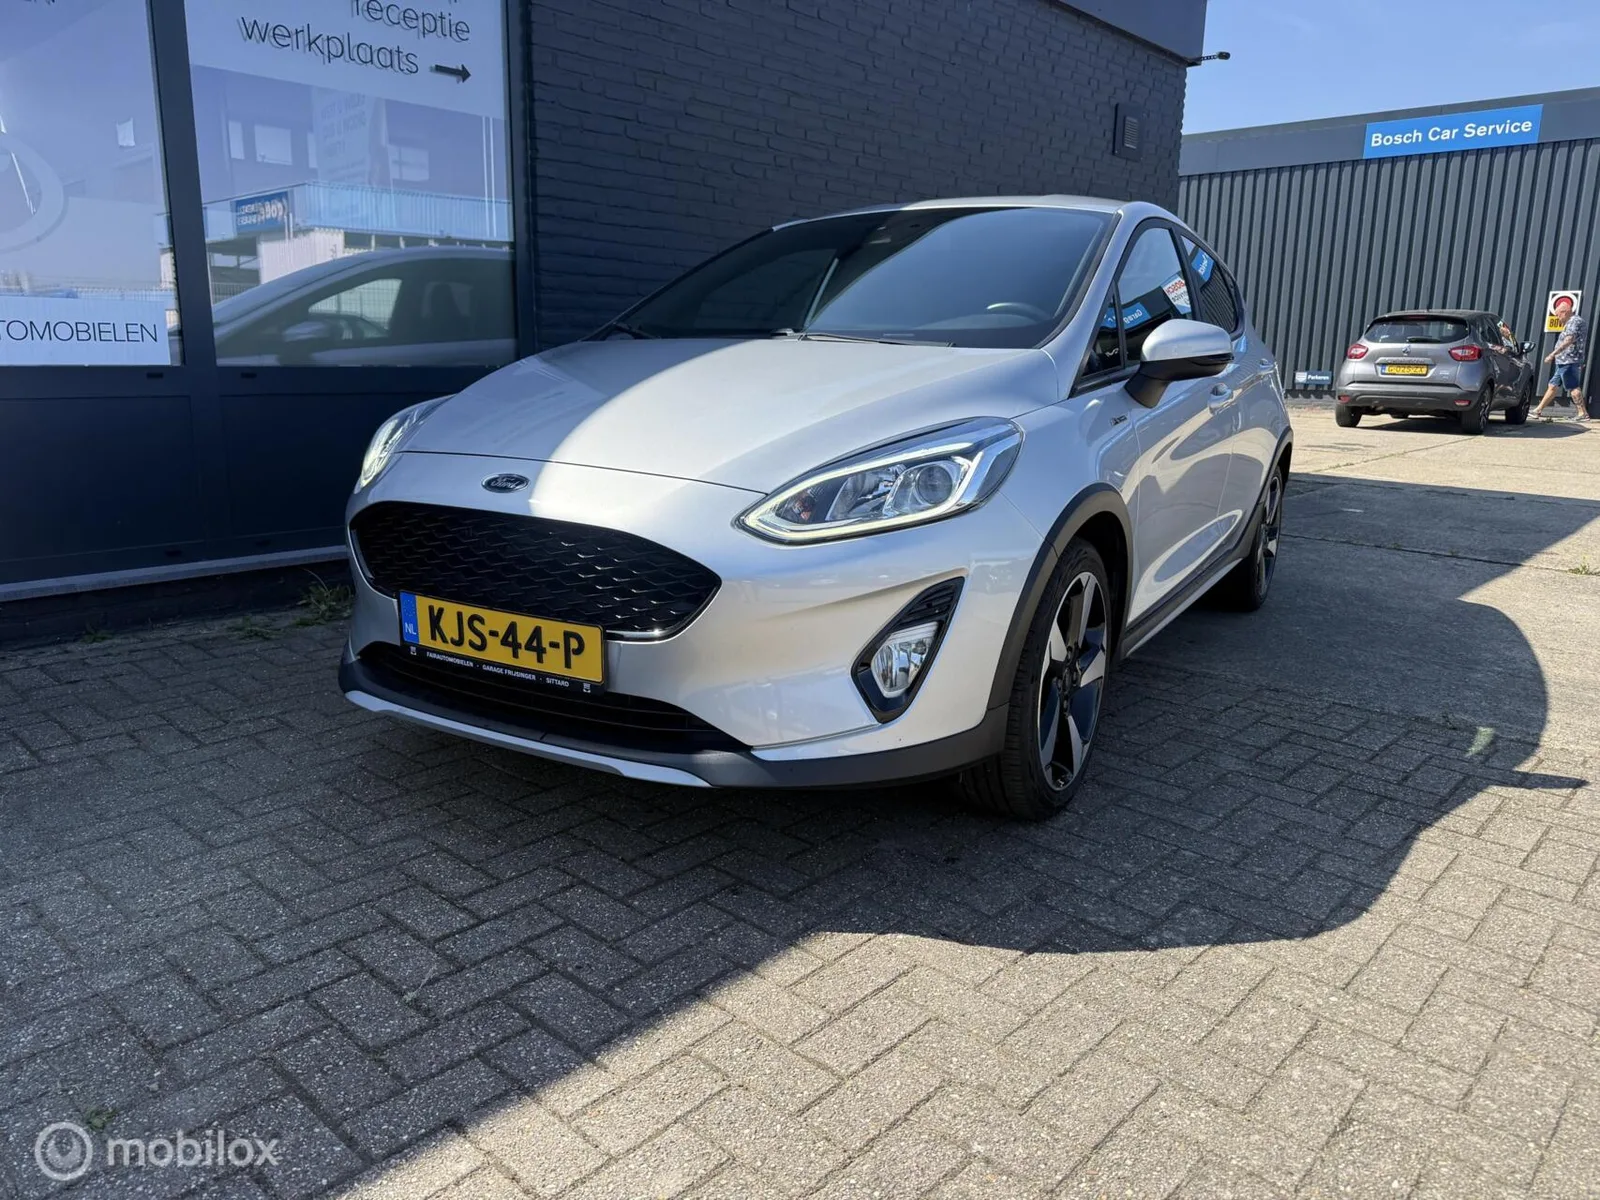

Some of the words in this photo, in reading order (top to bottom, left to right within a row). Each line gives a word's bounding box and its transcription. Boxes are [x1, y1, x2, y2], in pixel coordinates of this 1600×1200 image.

[240, 16, 419, 74] werkplaats
[1371, 129, 1422, 147] Bosch
[1428, 127, 1459, 140] Car
[1463, 119, 1533, 138] Service
[404, 622, 417, 636] NL
[428, 605, 585, 669] KJS-44-P
[482, 664, 504, 674] GARAGE
[546, 677, 570, 688] SITTARD
